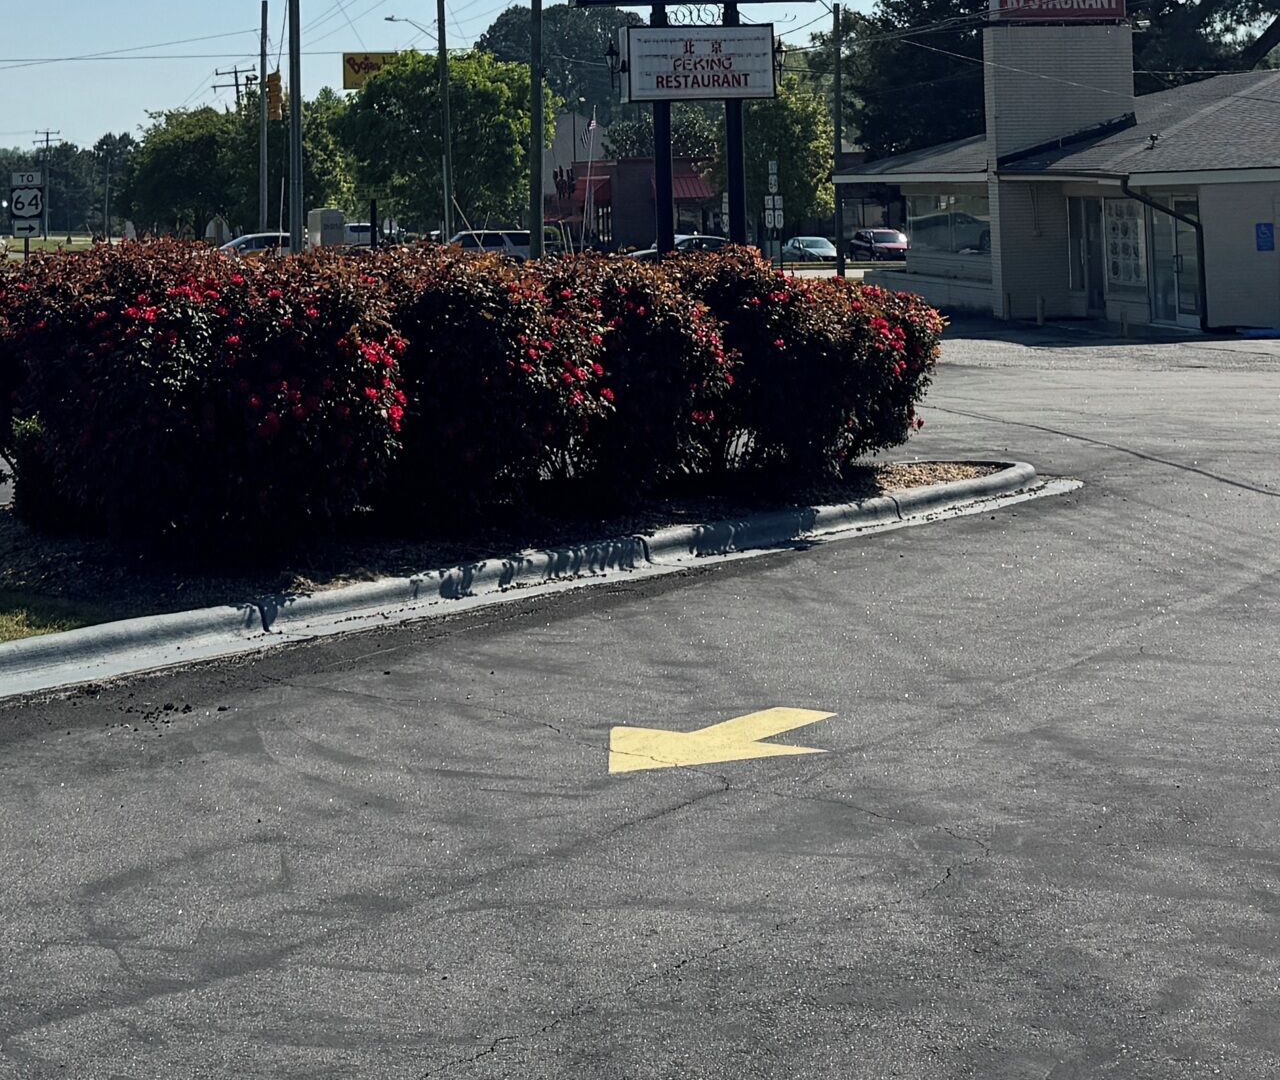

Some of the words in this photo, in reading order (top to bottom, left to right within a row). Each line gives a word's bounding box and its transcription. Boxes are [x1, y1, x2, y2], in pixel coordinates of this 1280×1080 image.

[673, 57, 732, 70] PEKING
[656, 73, 749, 89] RESTAURANT
[20, 174, 34, 183] TO
[14, 193, 40, 210] 64
